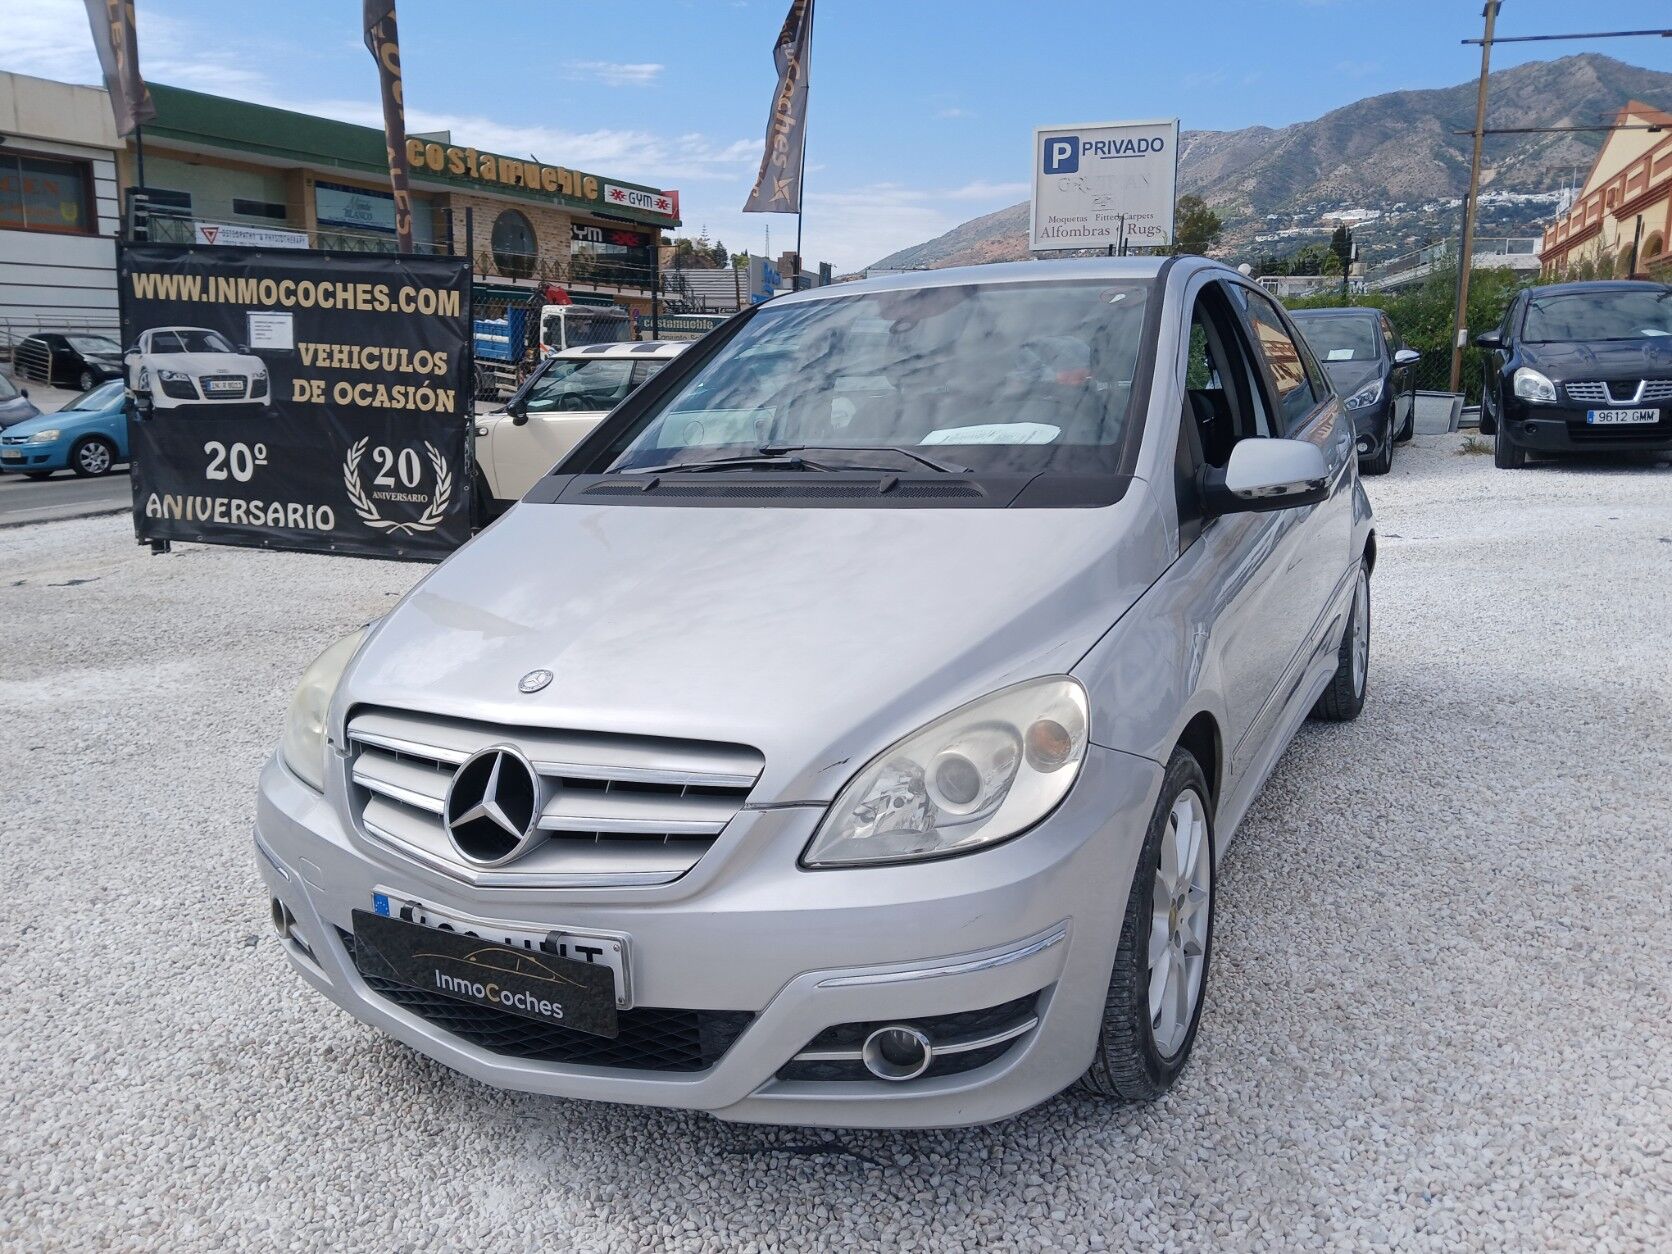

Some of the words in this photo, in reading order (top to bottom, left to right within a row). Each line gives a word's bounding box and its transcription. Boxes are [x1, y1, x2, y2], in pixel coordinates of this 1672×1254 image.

[406, 138, 598, 200] costamueble
[1052, 142, 1072, 169] P
[1082, 137, 1165, 156] PRIVADO
[628, 191, 653, 208] GYM
[569, 224, 603, 242] YM
[1040, 225, 1110, 239] Alfombras
[1127, 223, 1162, 237] Rugs
[1048, 215, 1088, 224] Moquetas
[1095, 212, 1120, 221] Fitted
[1123, 212, 1154, 222] Carpets
[131, 272, 460, 317] WWW.INMOCOCHES.COM
[297, 341, 448, 376] VEHICULOS
[292, 378, 326, 404] DE
[333, 379, 456, 413] OCASIÓN
[1598, 411, 1628, 422] 9612
[1632, 410, 1655, 421] GMM
[372, 446, 422, 489] 20
[145, 492, 335, 530] ANIVERSARIO
[372, 490, 428, 503] ANIVERSARIO
[435, 969, 564, 1019] InmoCoches
